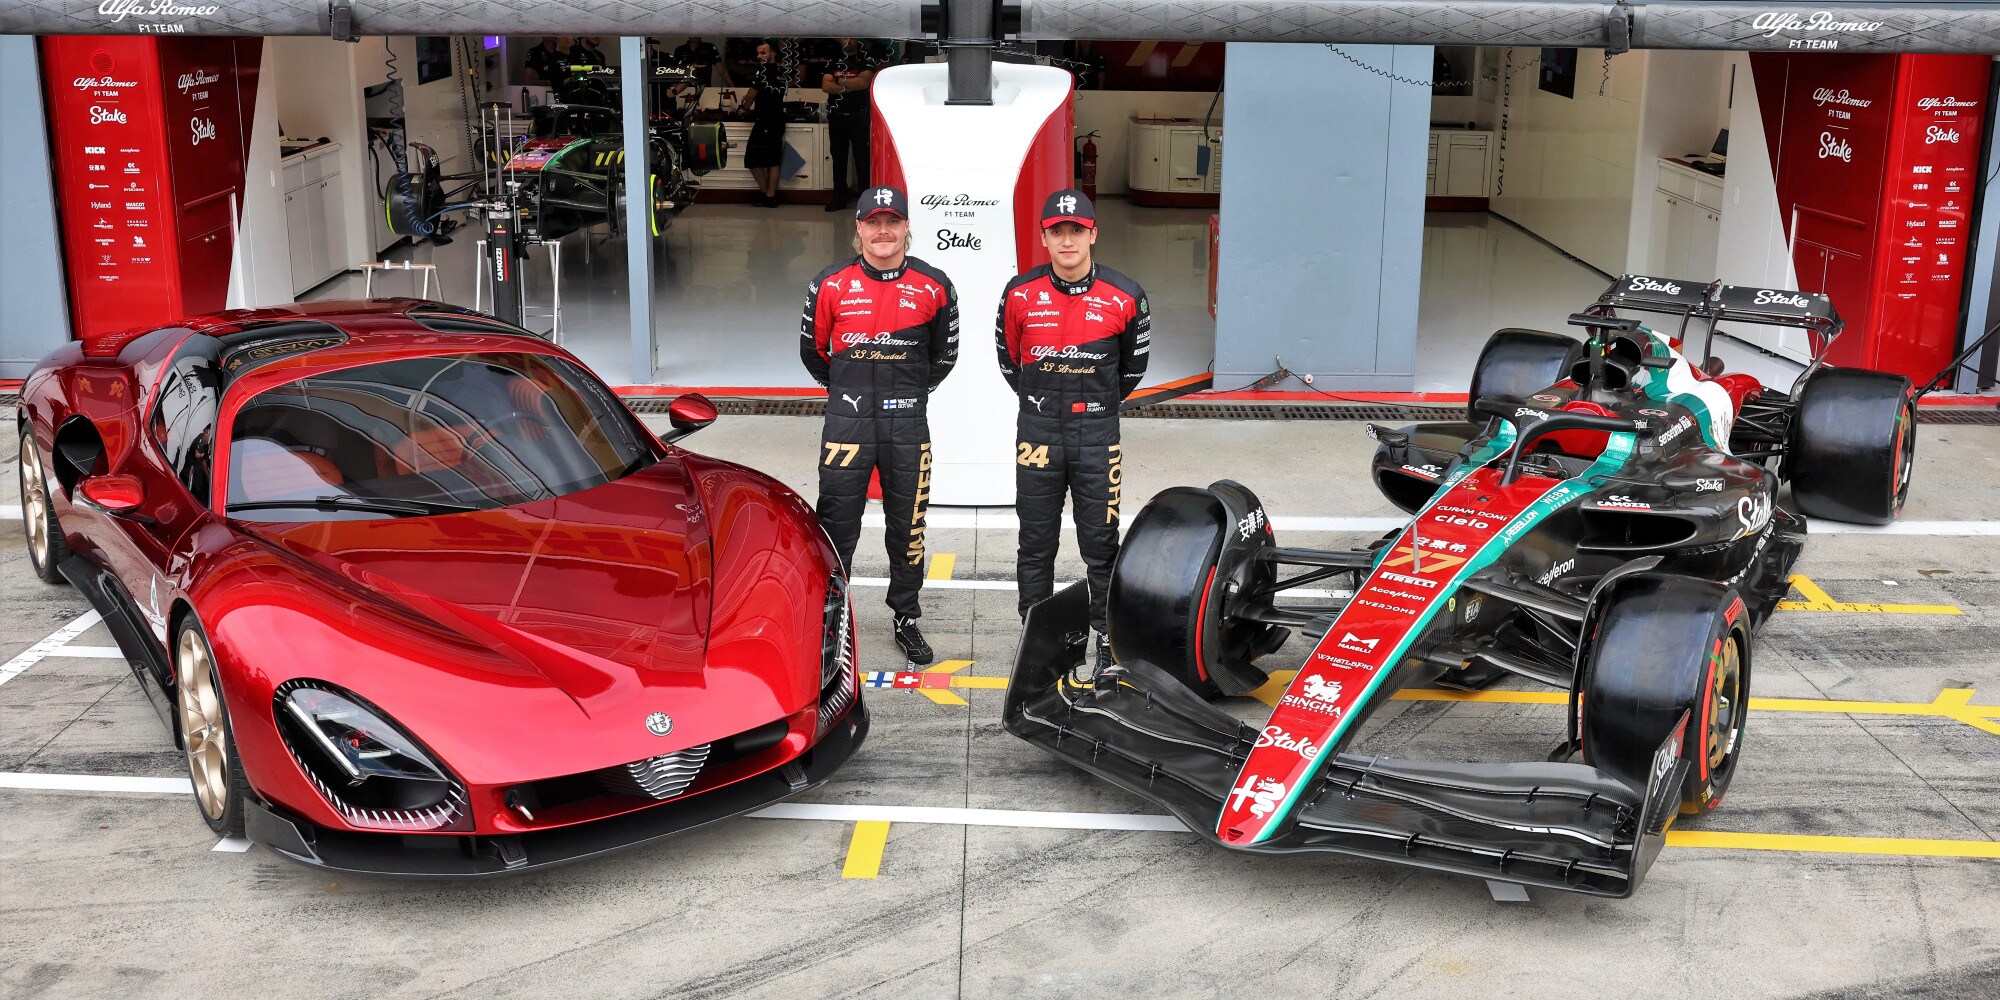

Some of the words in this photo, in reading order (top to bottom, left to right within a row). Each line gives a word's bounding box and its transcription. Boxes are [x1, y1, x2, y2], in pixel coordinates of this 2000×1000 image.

[98, 0, 147, 23] Alfa
[149, 0, 219, 16] Romeo
[138, 24, 150, 33] F1
[153, 24, 185, 33] TEAM
[1752, 11, 1806, 38] Alfa
[1806, 9, 1884, 32] Romeo
[1788, 39, 1802, 49] F1
[1804, 39, 1839, 50] TEAM
[655, 66, 686, 75] Stake
[73, 77, 99, 91] Alfa
[99, 76, 138, 87] Romeo
[177, 74, 196, 95] Alfa
[195, 69, 220, 86] Romeo
[197, 91, 209, 100] TEAM
[1812, 87, 1836, 107] Alfa
[1835, 89, 1872, 108] Romeo
[1917, 97, 1941, 111] Alfa
[1941, 96, 1978, 107] Romeo
[89, 105, 127, 125] Stake
[1828, 109, 1835, 118] F1
[1835, 110, 1851, 120] TEAM
[190, 116, 216, 146] Stake
[1925, 125, 1960, 144] Stake
[84, 146, 106, 154] KICK
[1497, 114, 1508, 197] VALTTERI
[1818, 131, 1852, 163] Stake
[1912, 165, 1933, 174] KICK
[920, 194, 952, 211] Alfa
[952, 193, 1001, 206] Romeo
[936, 228, 982, 251] Stake
[1628, 276, 1682, 295] Stake
[1753, 289, 1809, 308] Stake
[841, 332, 872, 348] Alfa
[872, 331, 919, 346] Romeo
[866, 350, 907, 360] Stradale
[1030, 345, 1061, 361] Alfa
[1060, 344, 1109, 360] Romeo
[1054, 364, 1096, 374] Stradale
[1514, 407, 1550, 421] Stake
[823, 441, 860, 467] 77
[1016, 442, 1050, 468] 24
[1695, 478, 1724, 492] Stake
[1437, 505, 1476, 515] CURAM
[1477, 511, 1508, 521] DOMI
[1596, 500, 1651, 509] CAMOZZI
[1434, 514, 1489, 529] cielo
[1381, 546, 1467, 574] 77
[1379, 571, 1438, 589] PIRELLI
[1357, 599, 1417, 615] EVERDOME
[1337, 642, 1372, 654] MARELLI
[1282, 694, 1341, 716] SINGHA
[1254, 725, 1318, 761] Stake
